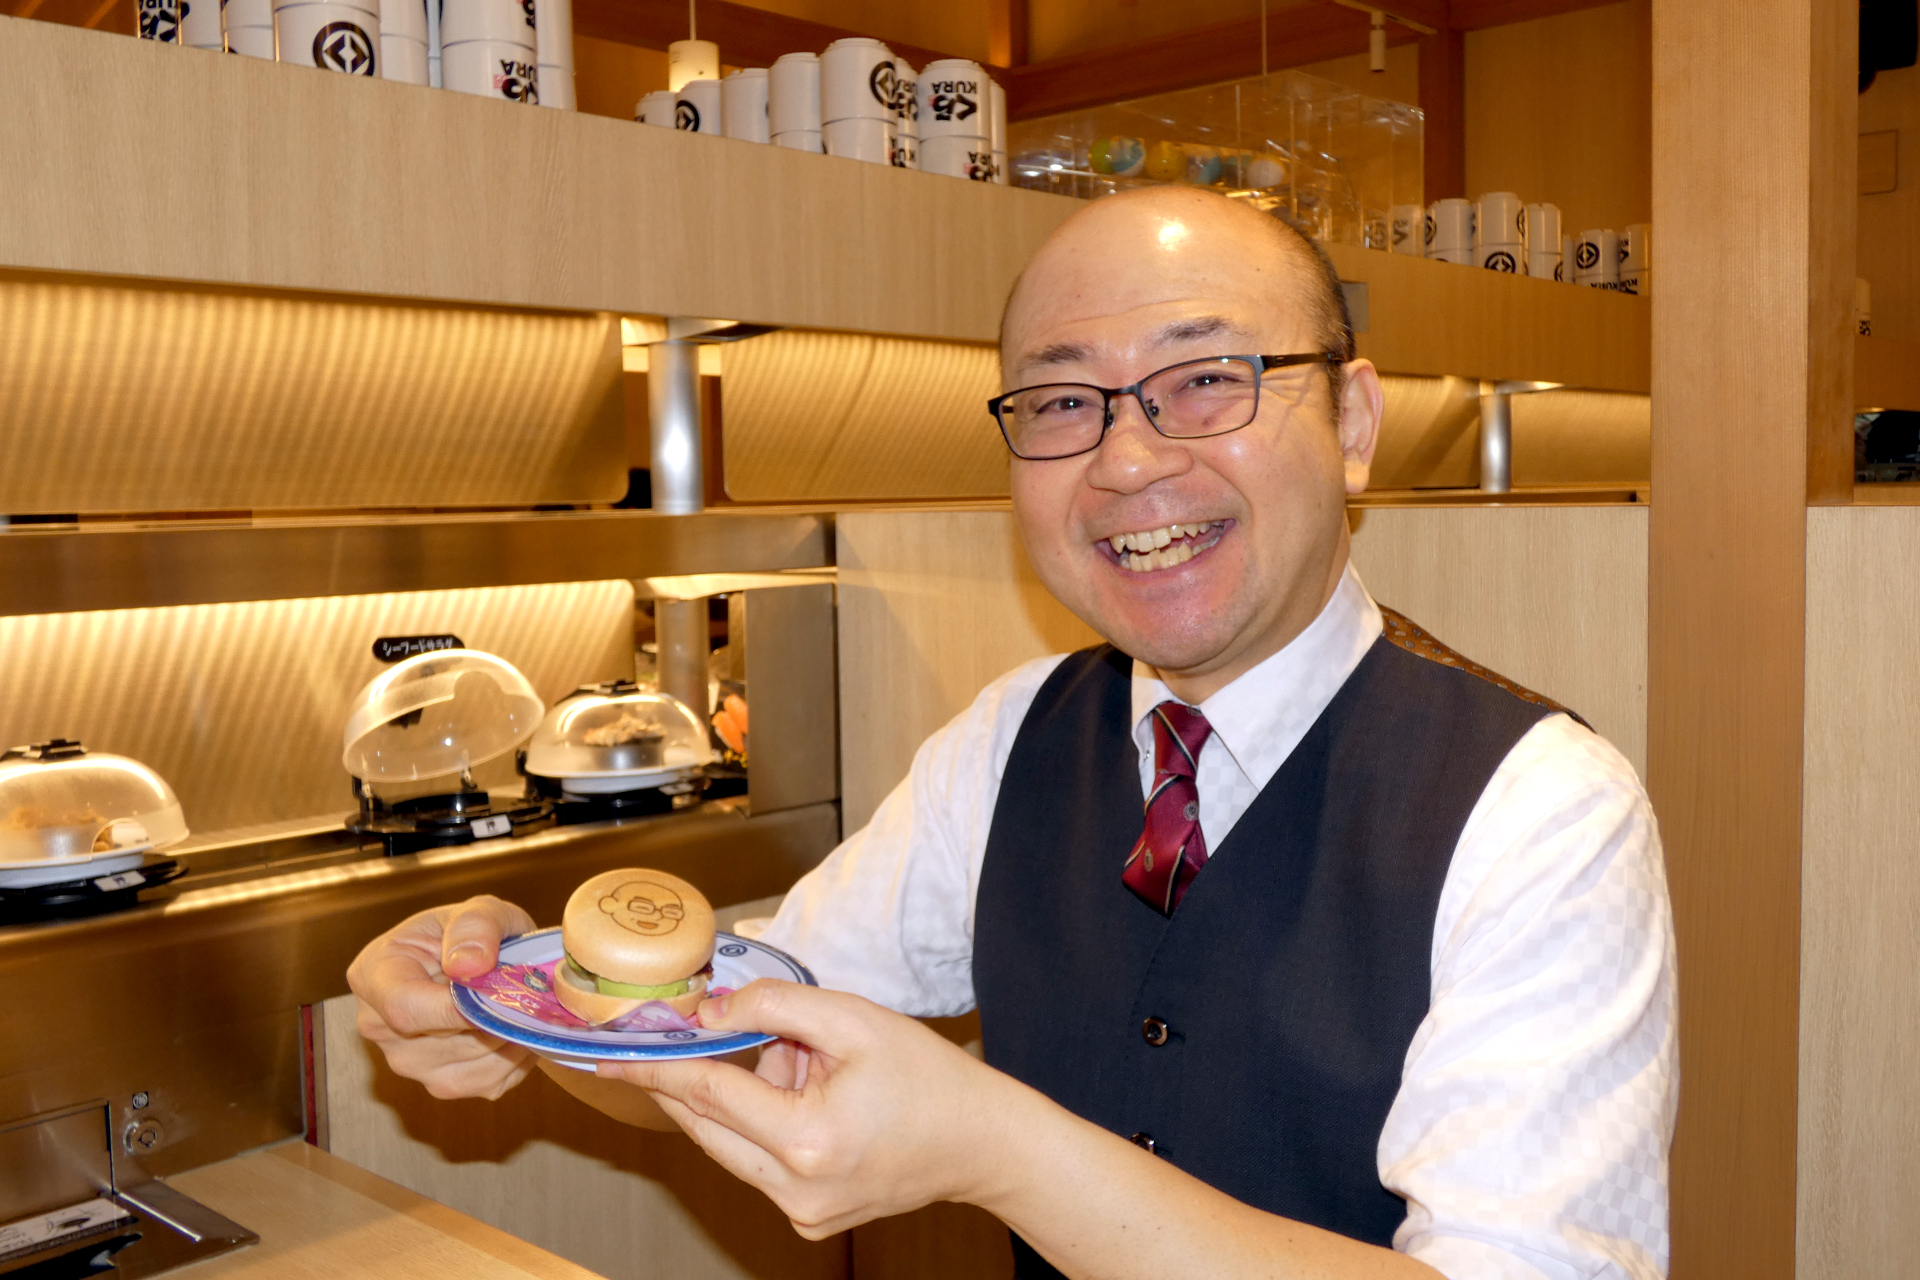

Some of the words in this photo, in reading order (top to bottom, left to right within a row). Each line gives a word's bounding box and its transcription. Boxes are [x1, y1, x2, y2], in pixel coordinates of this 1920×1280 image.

[499, 60, 537, 82] URA
[931, 80, 977, 94] KURA
[931, 94, 977, 121] くら
